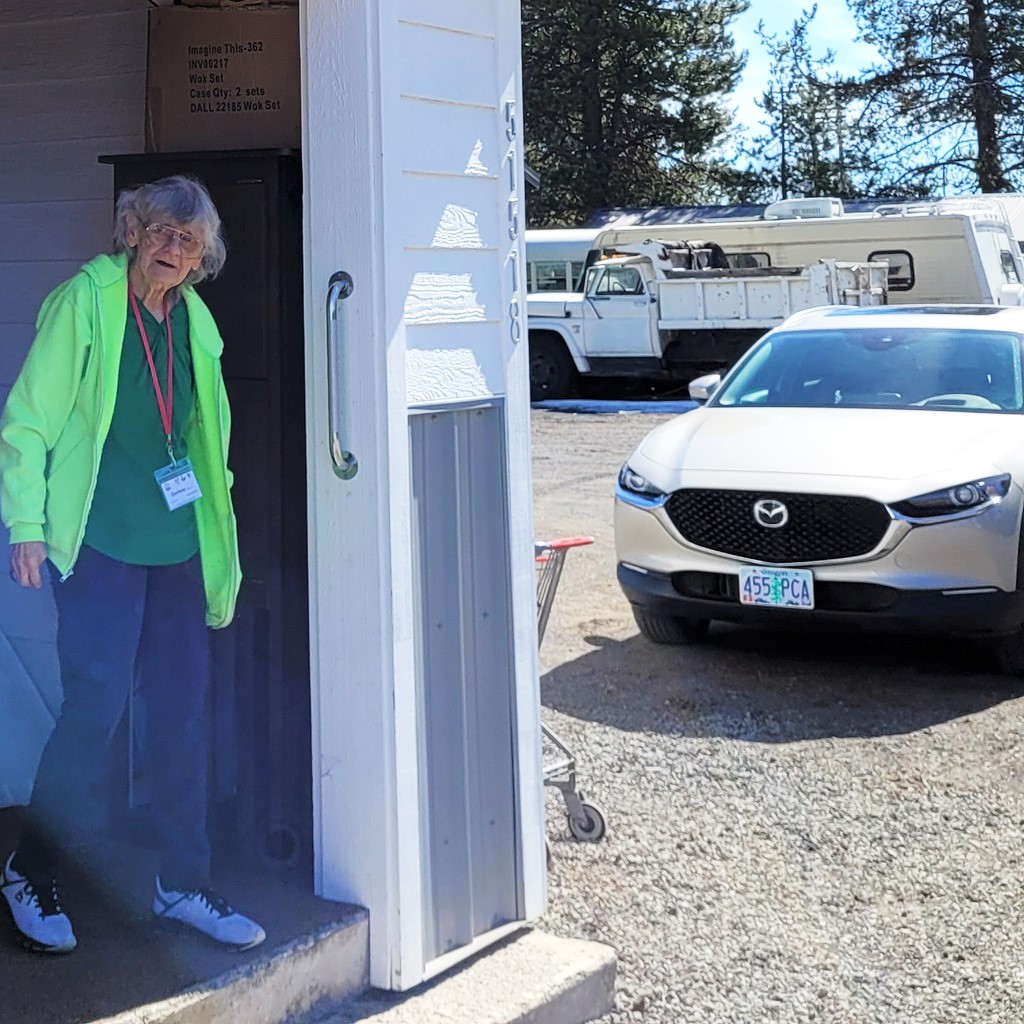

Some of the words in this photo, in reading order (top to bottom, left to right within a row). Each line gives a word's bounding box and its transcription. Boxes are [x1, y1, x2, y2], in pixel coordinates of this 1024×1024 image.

[188, 44, 222, 56] Imagine
[224, 41, 264, 53] This-362
[188, 59, 229, 69] INV00217
[189, 74, 207, 84] Wok
[209, 73, 224, 83] Set
[189, 88, 211, 98] Case
[212, 87, 232, 100] Qty:
[236, 87, 241, 97] 2
[245, 87, 266, 96] sets
[190, 102, 215, 113] DALL
[243, 100, 263, 111] Wok
[265, 100, 281, 110] Set
[743, 576, 771, 596] 455
[780, 577, 810, 601] PCA
